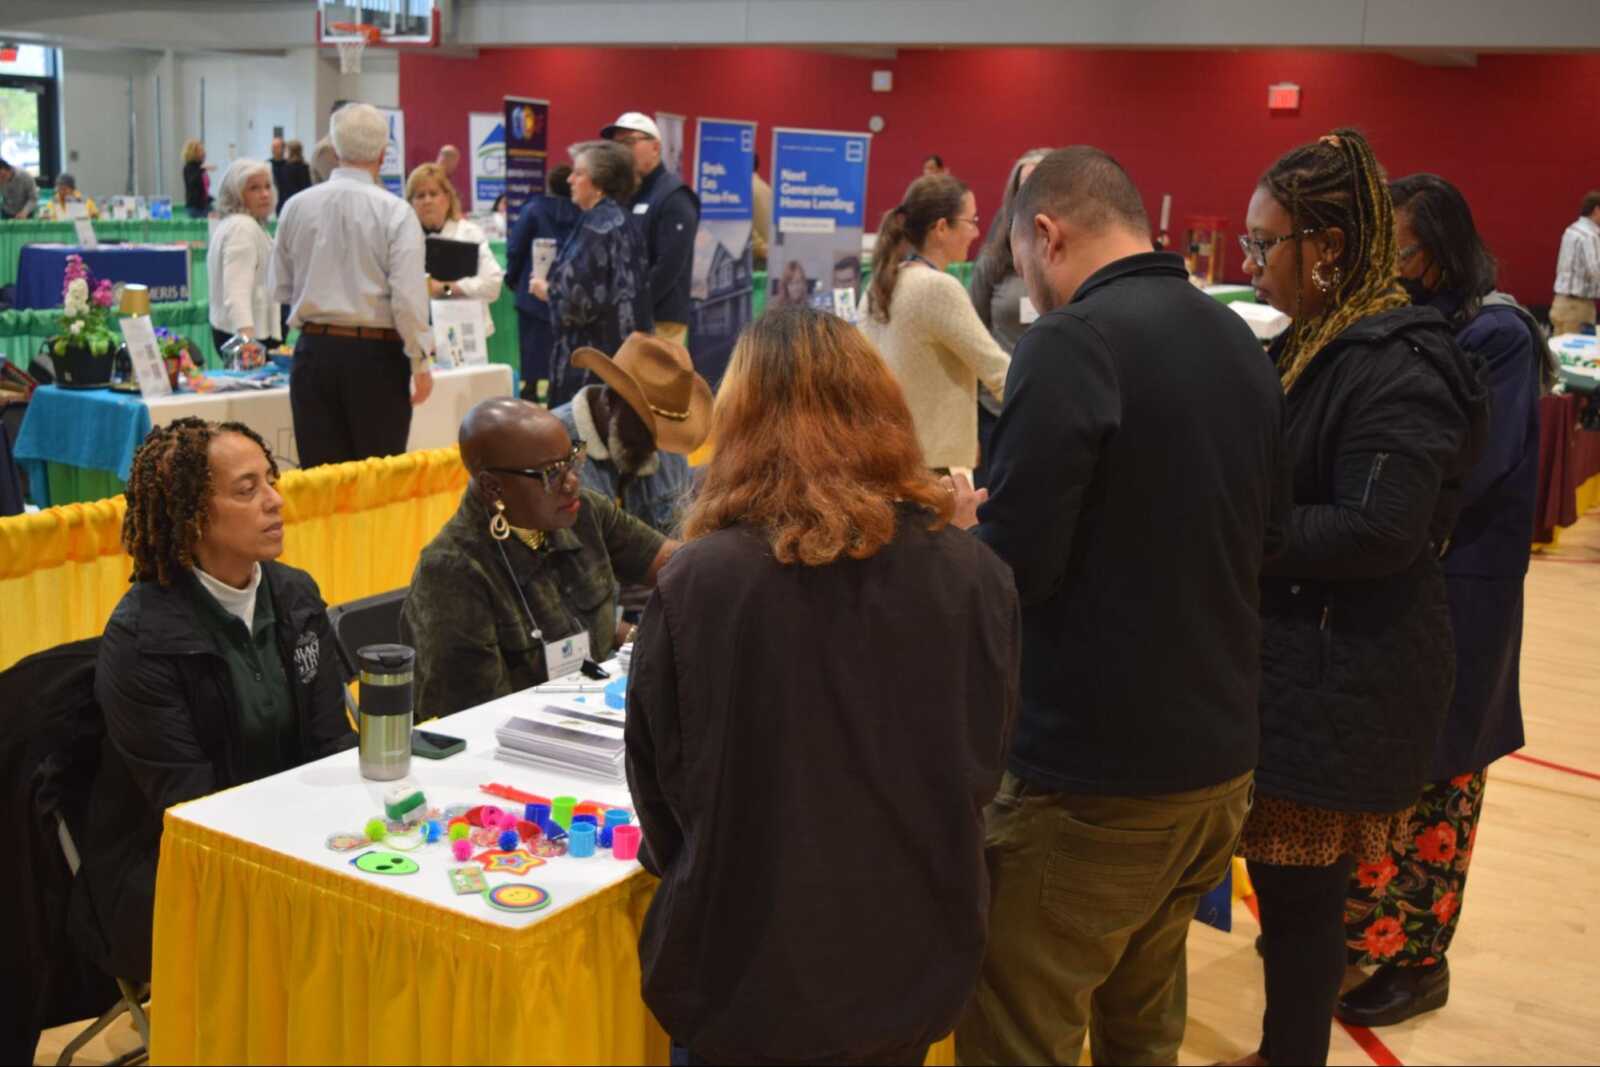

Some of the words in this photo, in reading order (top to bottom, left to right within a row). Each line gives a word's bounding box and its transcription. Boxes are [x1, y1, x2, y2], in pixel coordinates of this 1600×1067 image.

[781, 170, 806, 181] Next
[781, 183, 838, 196] Generation
[781, 196, 811, 209] Home
[812, 198, 854, 214] Lending
